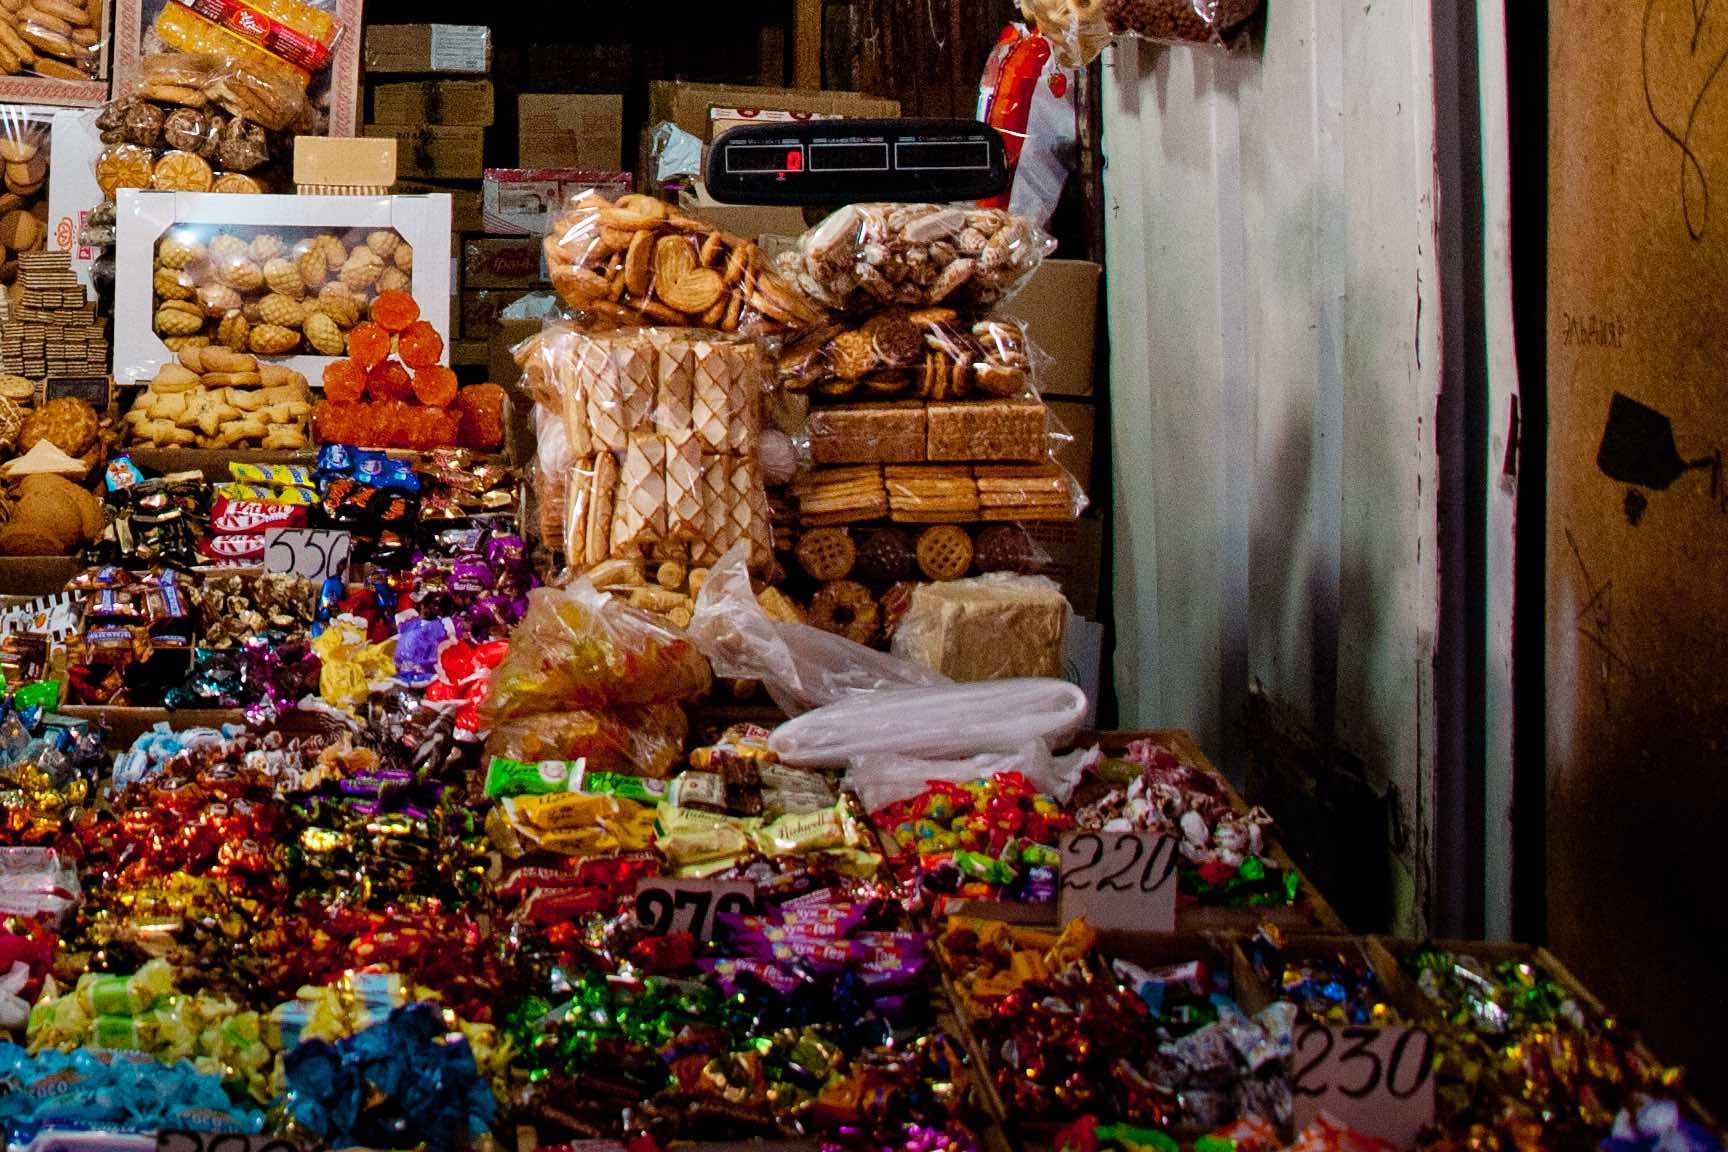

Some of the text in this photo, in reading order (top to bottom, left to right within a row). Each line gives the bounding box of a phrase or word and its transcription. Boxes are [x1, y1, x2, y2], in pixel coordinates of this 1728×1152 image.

[269, 529, 349, 579] 550
[1058, 833, 1178, 893] 220
[1294, 1026, 1433, 1098] 230
